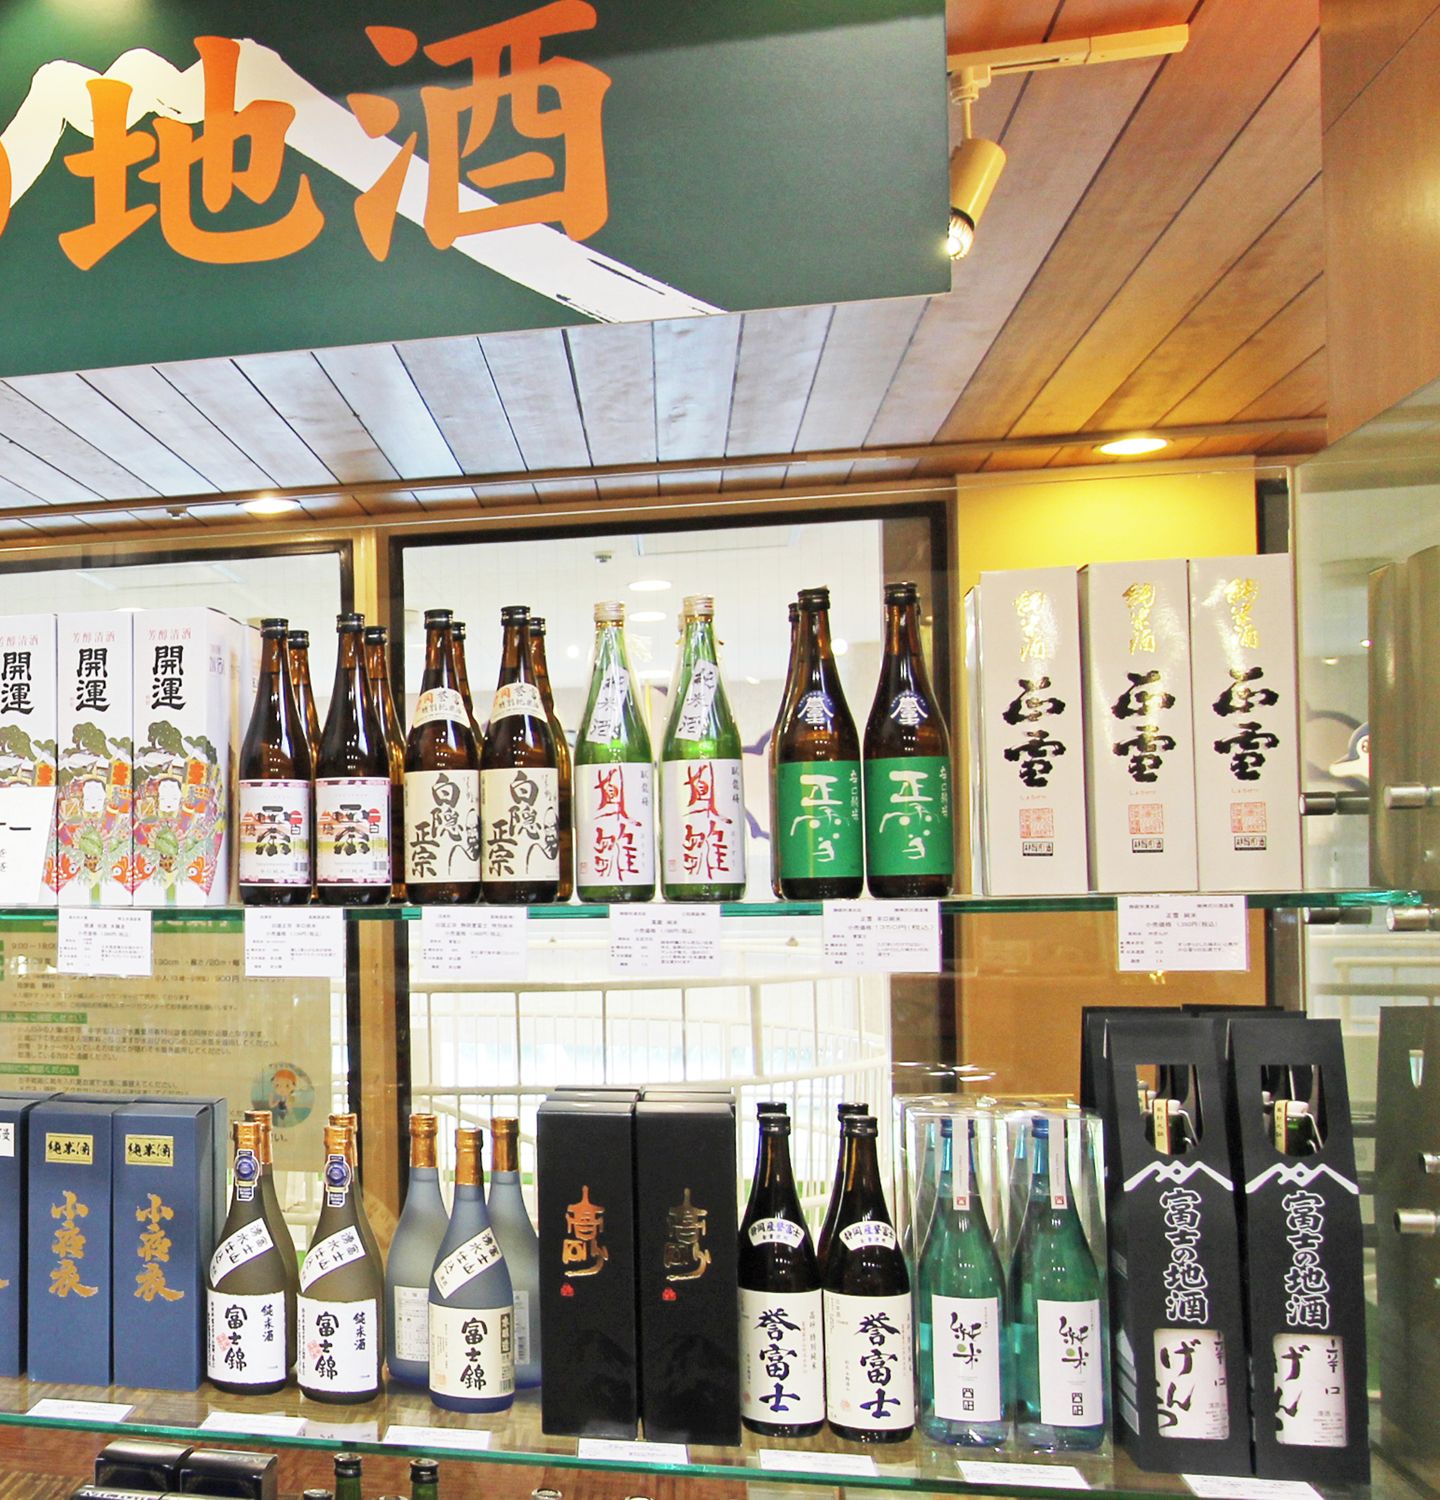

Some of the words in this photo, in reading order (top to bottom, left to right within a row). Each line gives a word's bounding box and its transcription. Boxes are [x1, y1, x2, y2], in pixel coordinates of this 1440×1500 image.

[0, 651, 35, 715] 開運
[75, 648, 110, 712] 開運
[151, 645, 186, 710] 開運
[431, 772, 463, 841] 白隠
[509, 770, 542, 840] 白隠
[410, 819, 440, 878] 正宗
[487, 819, 518, 878] 正宗
[1159, 1187, 1209, 1325] 富士の地酒
[1281, 1190, 1331, 1329] 富士の地酒
[224, 1304, 248, 1372] 富士錦
[315, 1311, 339, 1381] 富士錦
[460, 1317, 488, 1390] 富士錦
[754, 1308, 801, 1413] 誉富士
[854, 1312, 901, 1419] 誉富士
